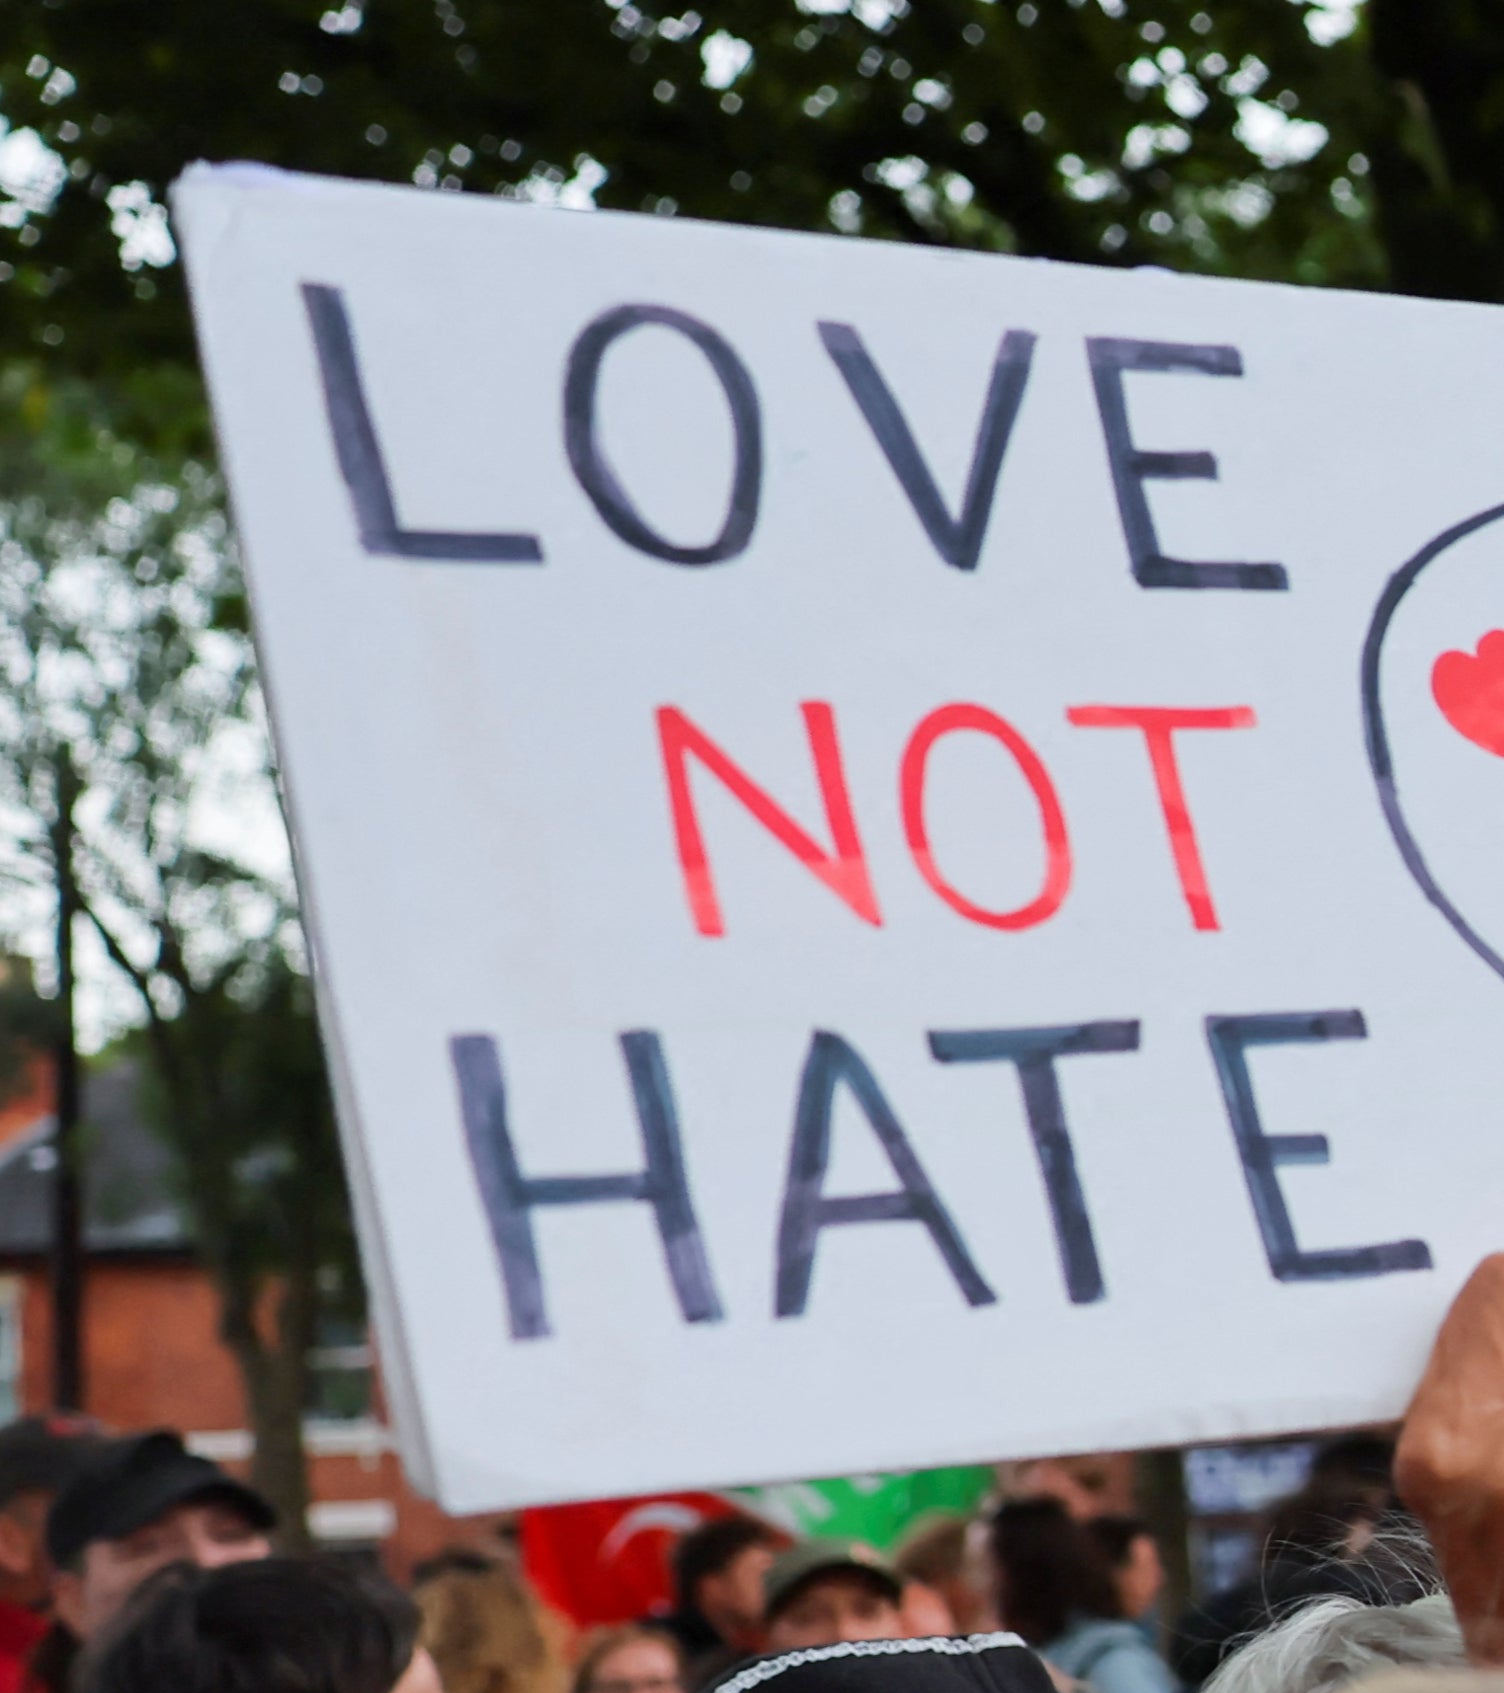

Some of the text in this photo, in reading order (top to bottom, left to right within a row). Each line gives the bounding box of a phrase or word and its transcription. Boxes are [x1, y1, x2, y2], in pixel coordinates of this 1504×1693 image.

[300, 282, 1289, 592] LOVE
[654, 700, 1258, 940] NOT
[446, 1007, 1434, 1341] HATE
